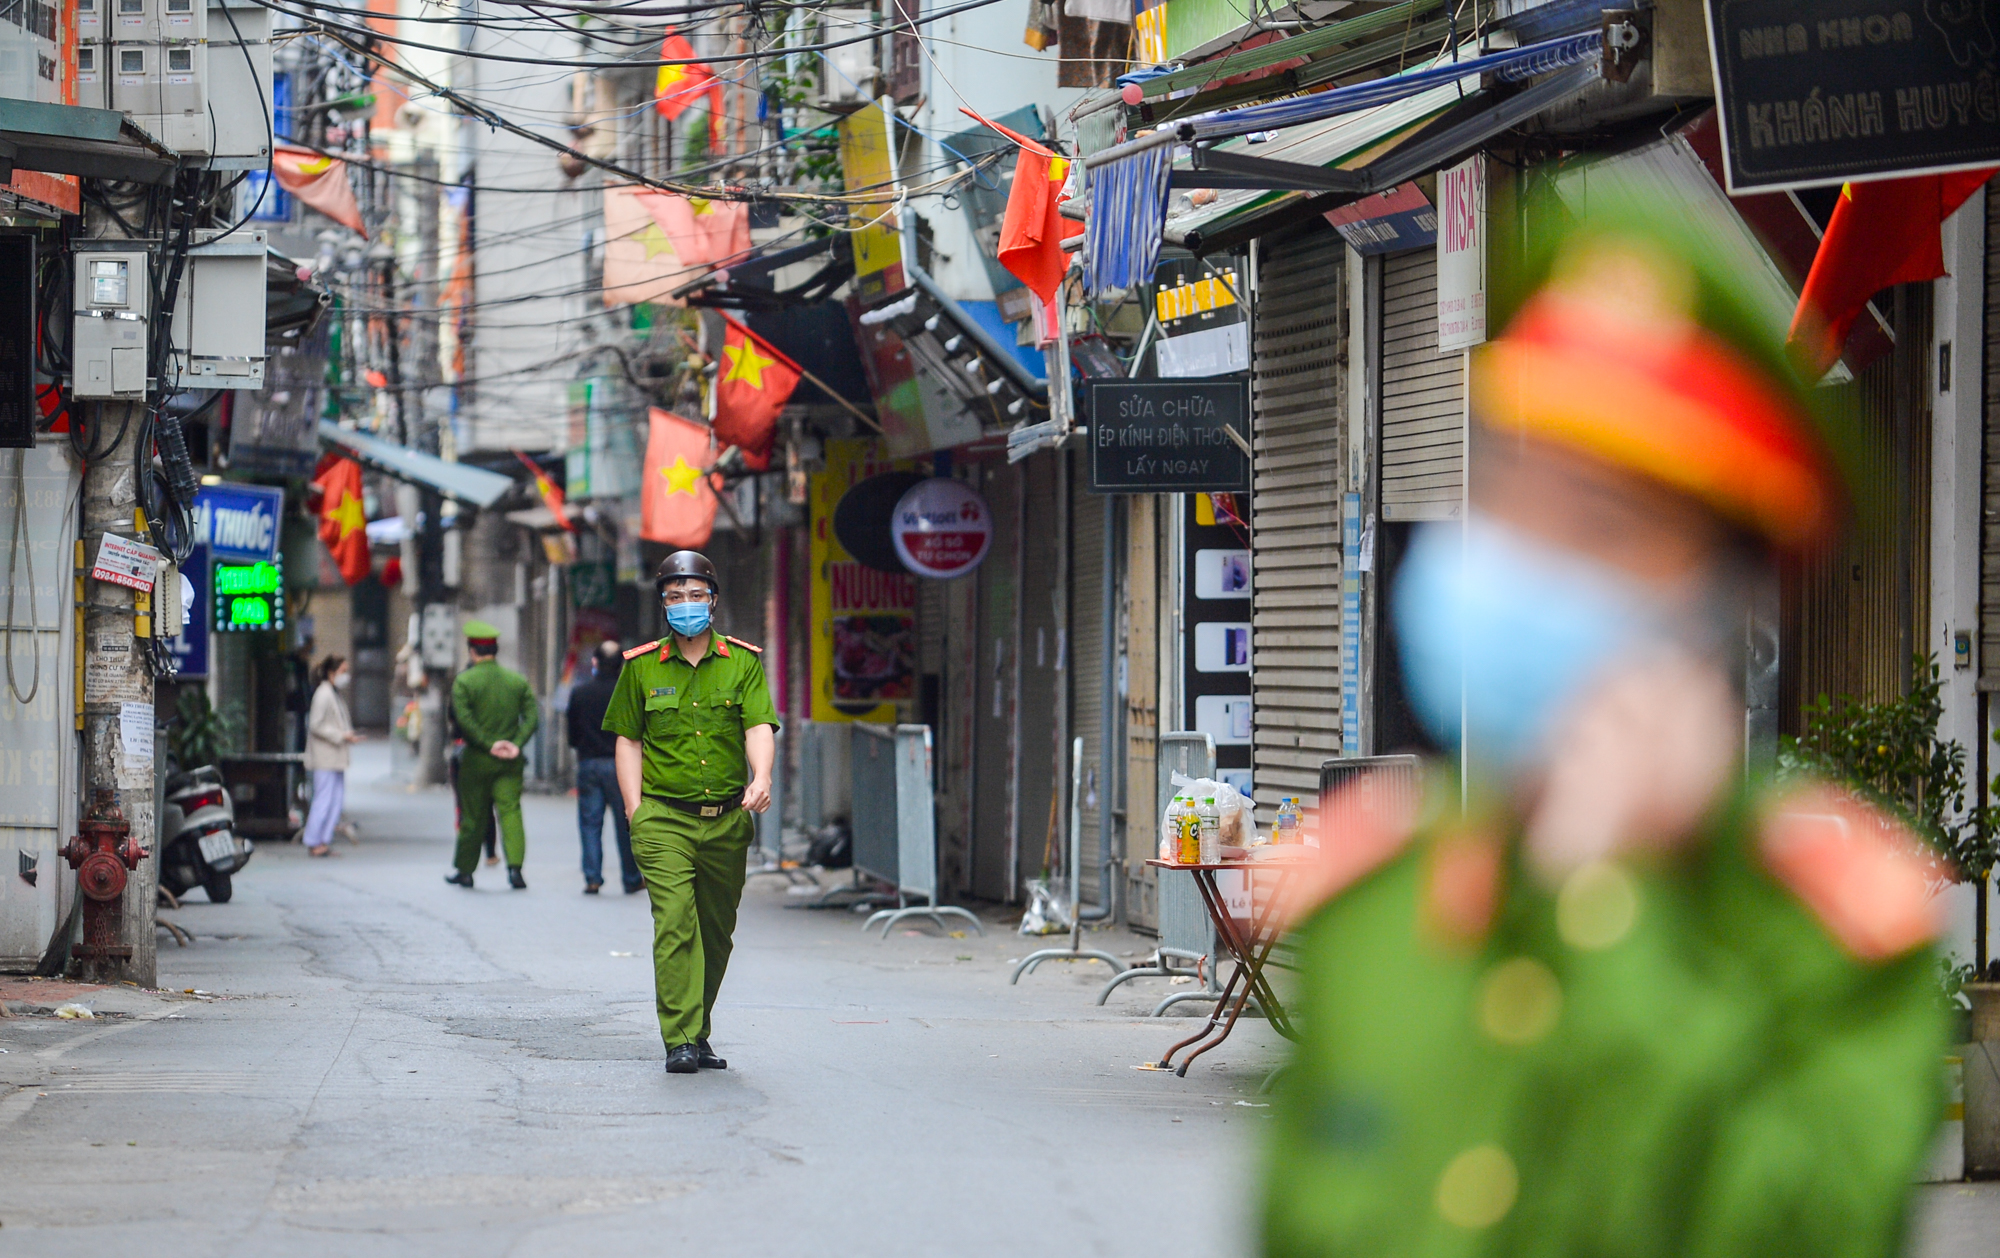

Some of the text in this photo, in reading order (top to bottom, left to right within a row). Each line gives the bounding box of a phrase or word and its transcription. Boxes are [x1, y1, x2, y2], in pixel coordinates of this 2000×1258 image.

[1747, 86, 1884, 148] KHÁNH
[1445, 166, 1476, 254] MISA
[1119, 394, 1216, 417] SỬA CHỮA
[1098, 422, 1237, 449] ÉP KÍNH ĐIỆN THOẠ
[1127, 454, 1209, 475] LẤY NGAY
[214, 501, 272, 551] THUỐC
[104, 542, 126, 552] INTERNET
[138, 551, 157, 561] QUANG
[94, 569, 150, 591] 0984.850.400
